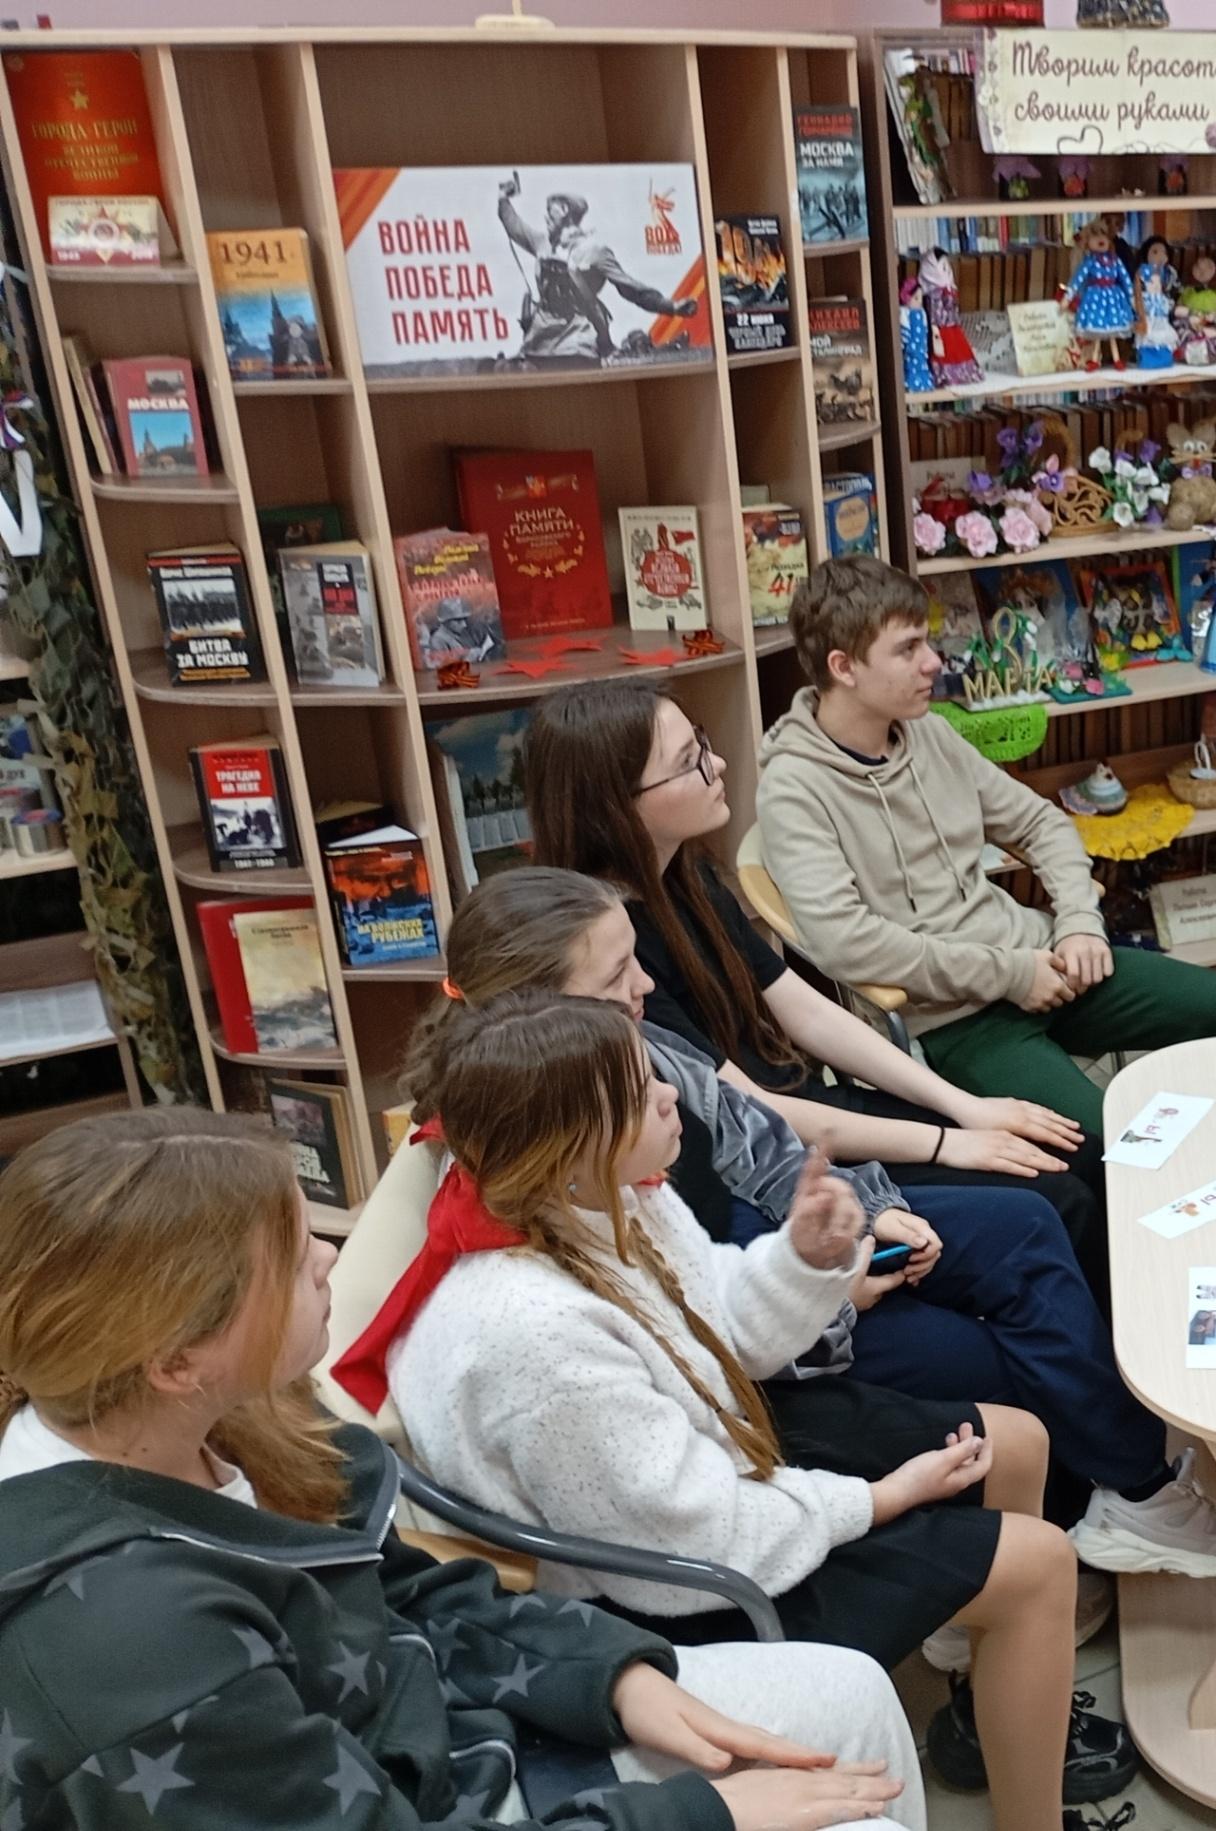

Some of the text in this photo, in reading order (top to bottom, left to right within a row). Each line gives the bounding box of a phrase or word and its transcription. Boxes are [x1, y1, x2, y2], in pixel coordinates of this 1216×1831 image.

[1011, 40, 1119, 86] Творим
[1014, 91, 1211, 131] своими руками
[800, 141, 854, 157] МОСКВА
[377, 214, 470, 255] ВОЙНА
[221, 240, 287, 265] 1941
[385, 263, 493, 302] ПОБЕДА
[391, 308, 509, 345] ПАМЯТЬ
[127, 397, 189, 411] МОСКВА
[514, 507, 566, 522] КНИГА
[509, 519, 574, 536] ПАМЯТИ
[188, 638, 232, 654] БИТВА
[176, 651, 249, 668] ЗА МОСКВУ
